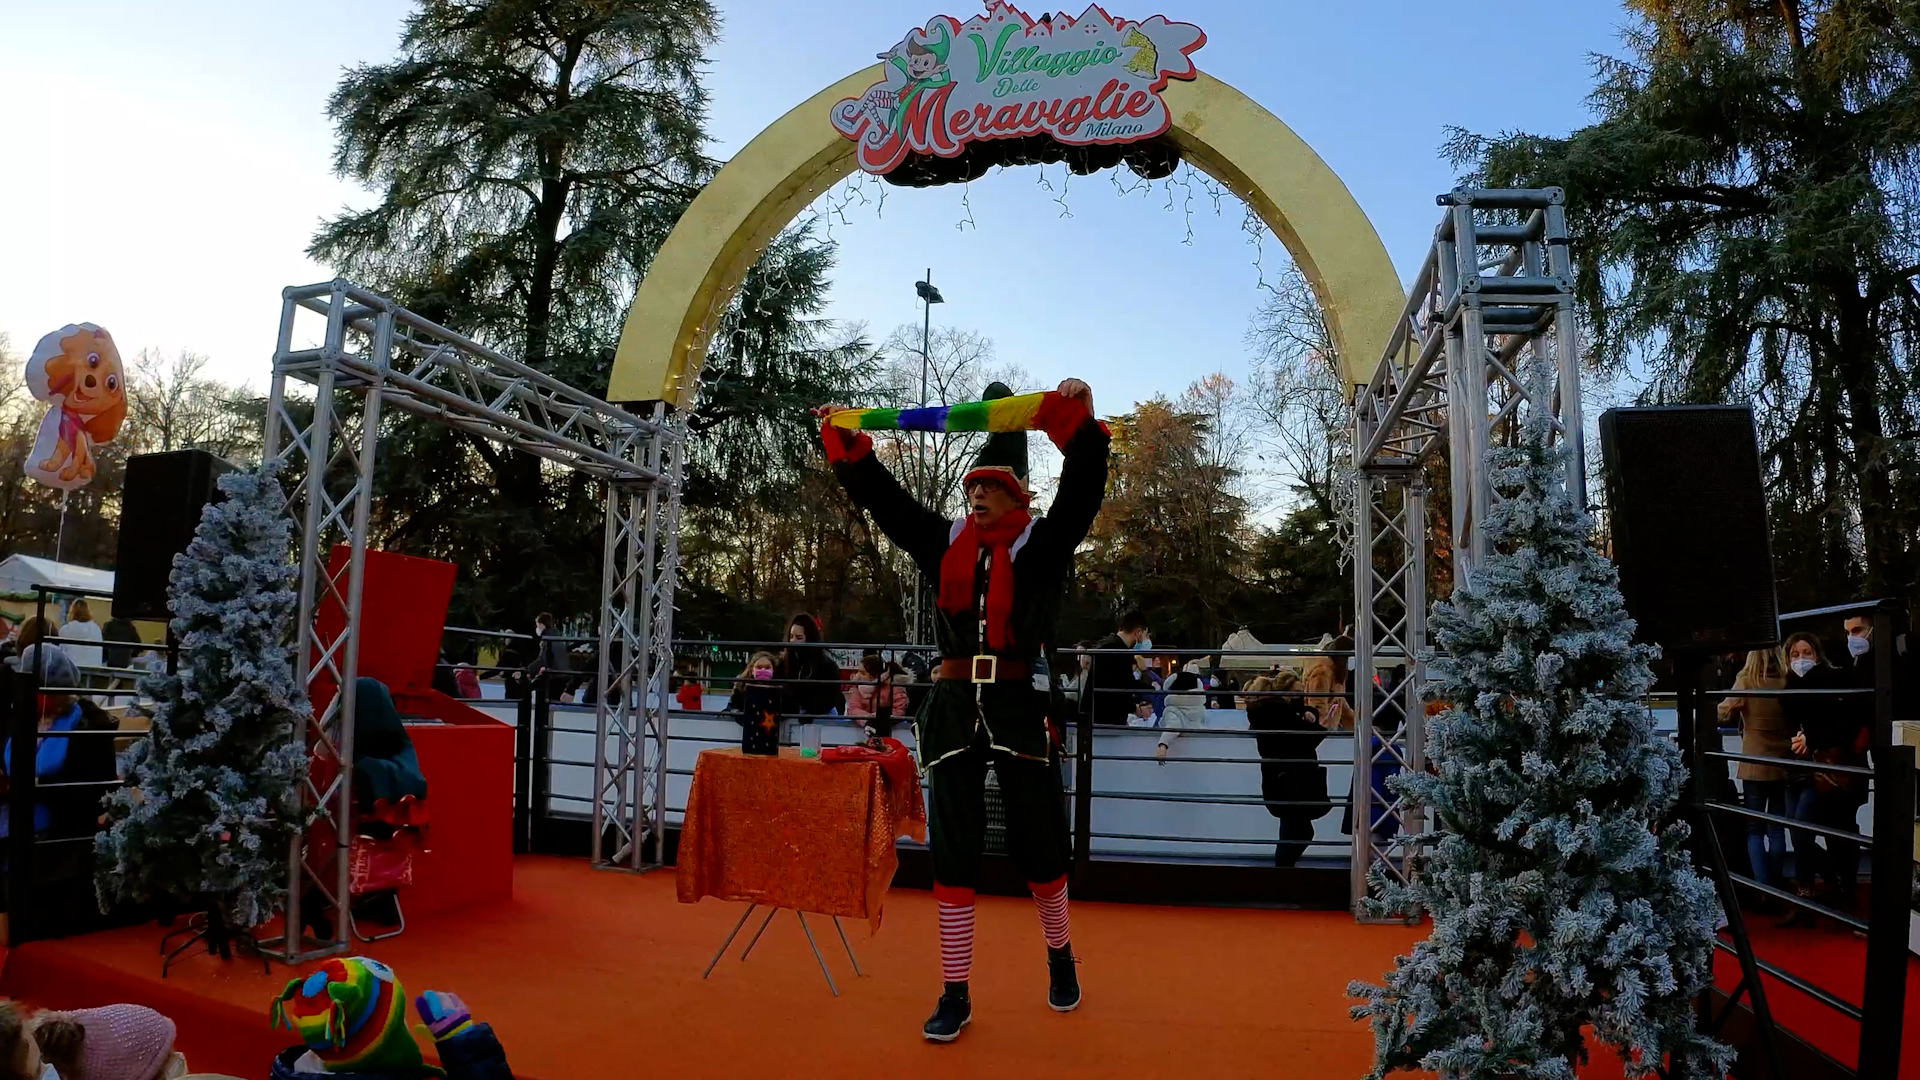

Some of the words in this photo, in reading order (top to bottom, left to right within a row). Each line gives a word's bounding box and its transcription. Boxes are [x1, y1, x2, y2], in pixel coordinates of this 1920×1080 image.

[967, 23, 1123, 83] Villaggio
[992, 77, 1041, 98] Delle
[863, 78, 1155, 165] Meraviglie
[1084, 122, 1145, 138] Milano
